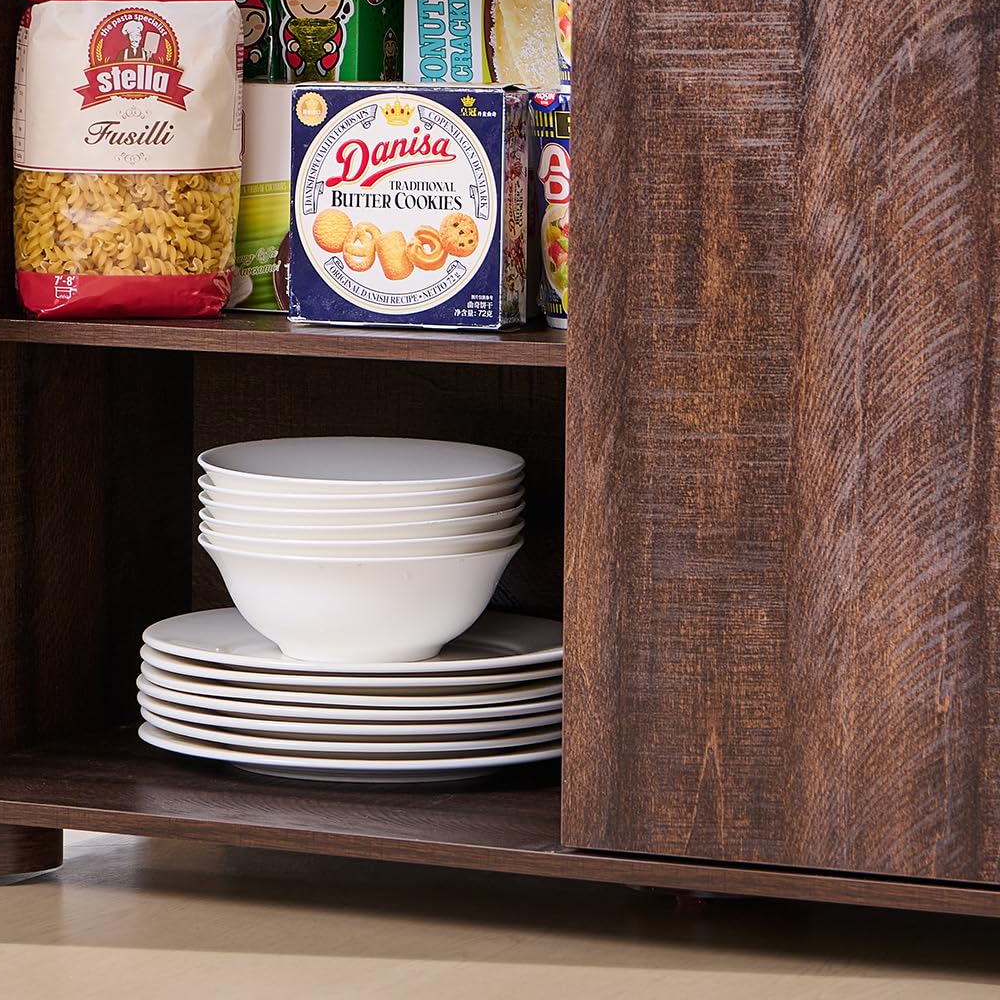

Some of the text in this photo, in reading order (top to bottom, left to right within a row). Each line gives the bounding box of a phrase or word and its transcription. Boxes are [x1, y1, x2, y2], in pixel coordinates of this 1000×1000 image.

[100, 14, 168, 37] the pasta specialist
[96, 64, 170, 93] stella
[84, 120, 175, 145] Fusilli
[428, 111, 476, 162] COPENHAGEN
[325, 126, 457, 188] Danisa
[389, 180, 456, 193] TRADITIONAL
[331, 190, 463, 211] BUTTER COOKIES
[329, 265, 361, 296] ORIGINAL
[360, 288, 389, 303] DANISH
[389, 295, 419, 304] RECIPE
[422, 282, 447, 298] NETTO
